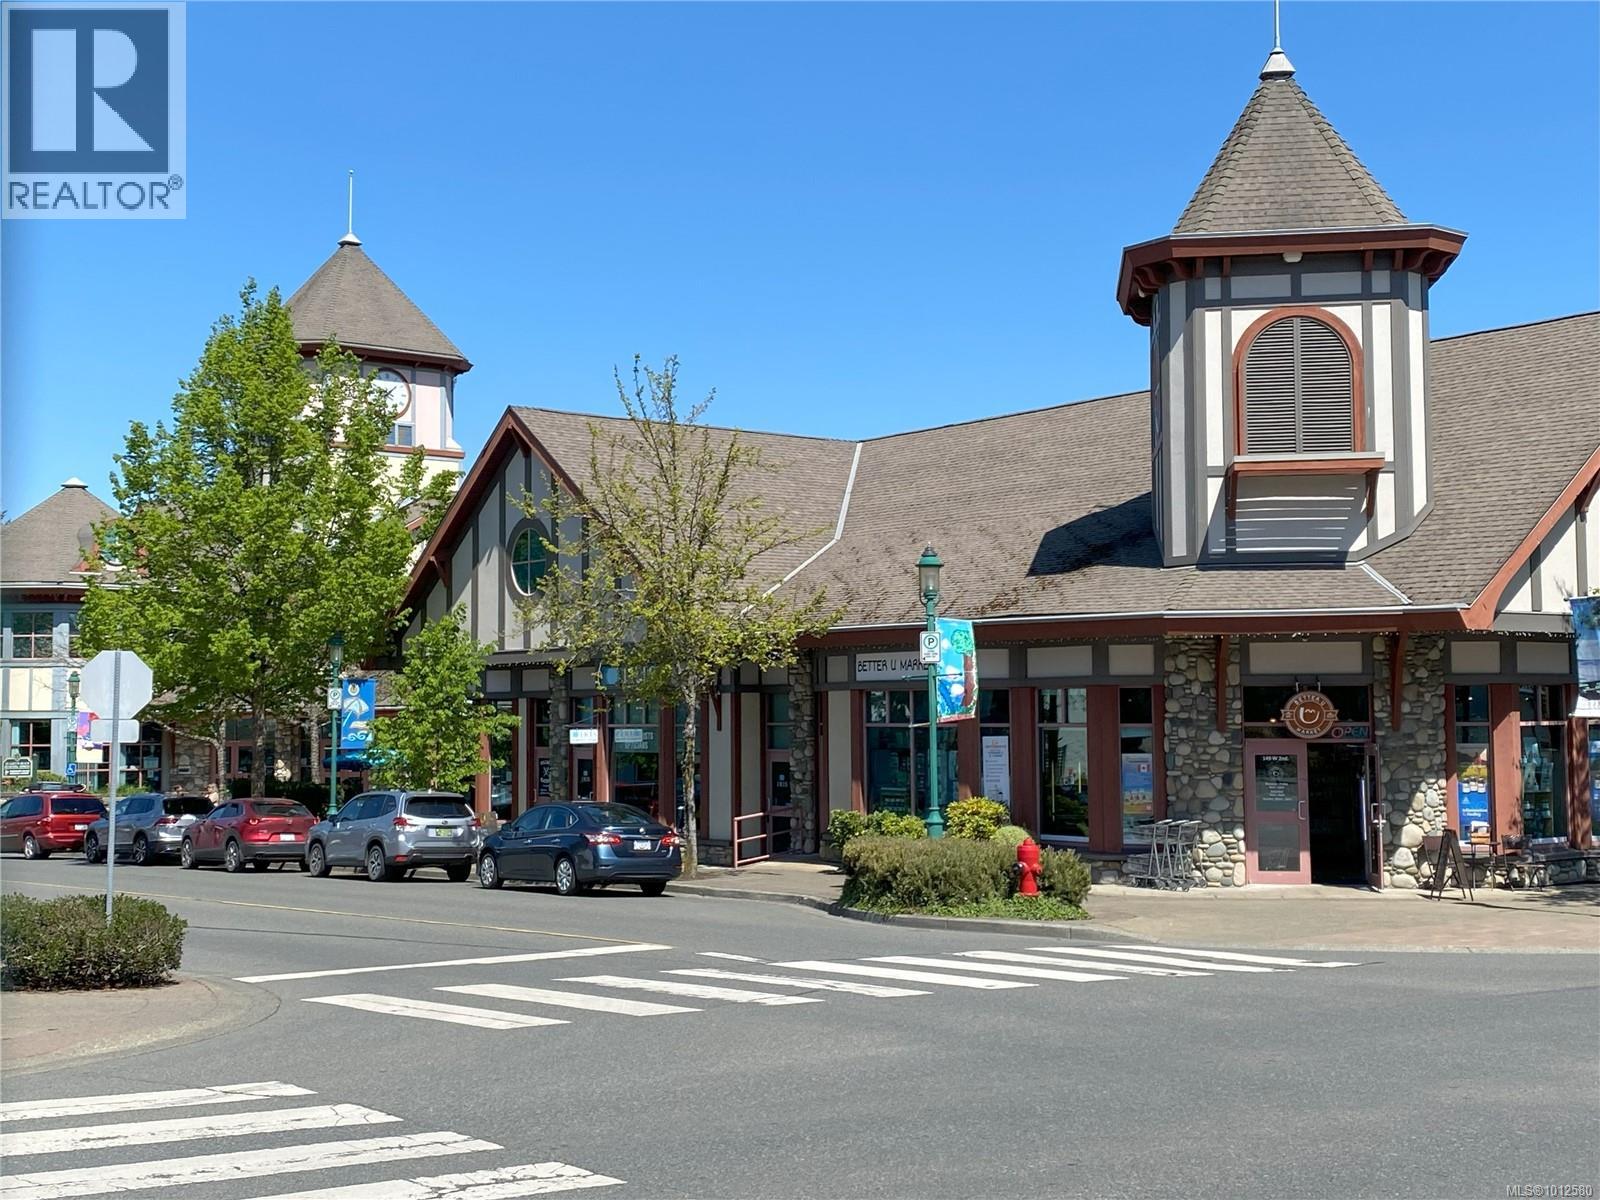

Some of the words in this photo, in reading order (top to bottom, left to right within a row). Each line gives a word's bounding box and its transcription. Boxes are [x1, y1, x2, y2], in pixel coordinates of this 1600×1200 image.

[857, 659, 888, 673] BETTER
[890, 659, 897, 671] U
[900, 658, 928, 671] MARKE
[1331, 726, 1369, 739] OPEN
